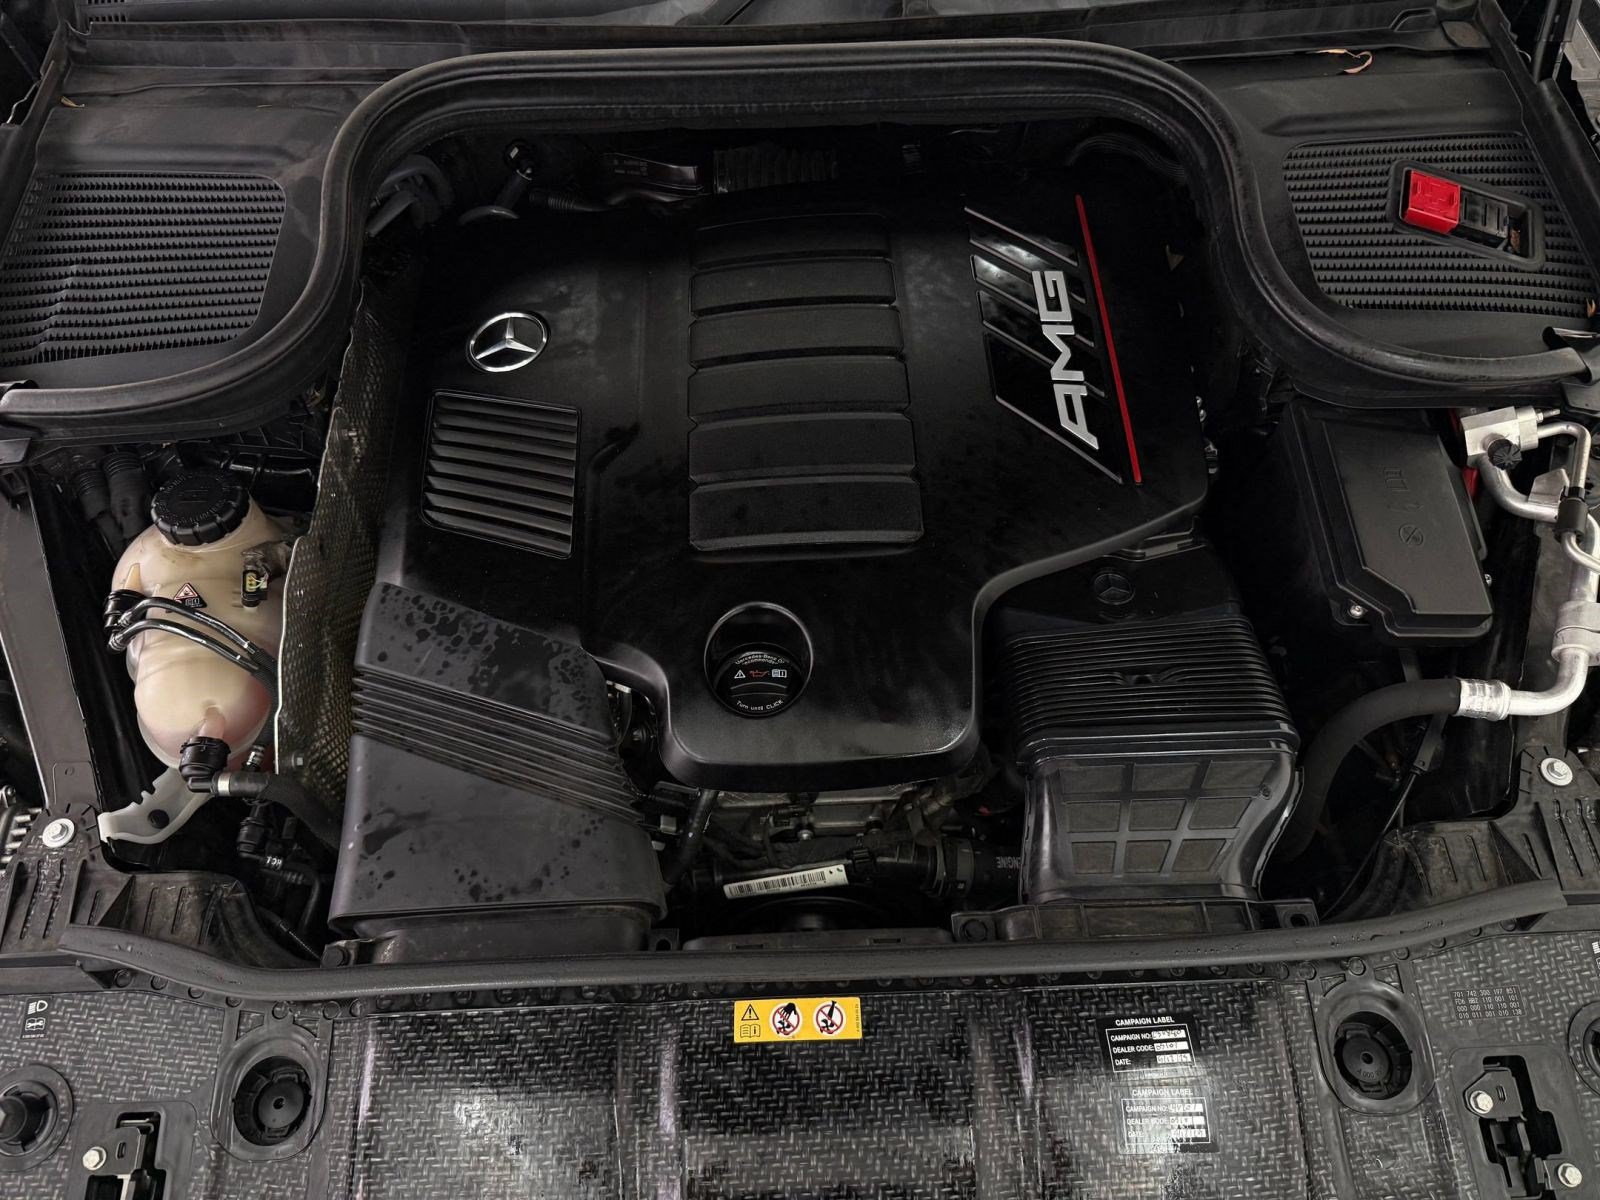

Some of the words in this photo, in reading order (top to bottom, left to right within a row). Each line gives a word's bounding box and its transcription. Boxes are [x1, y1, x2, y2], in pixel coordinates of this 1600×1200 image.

[1032, 271, 1099, 450] AMG
[736, 700, 748, 709] Turn
[1115, 1018, 1152, 1026] CAMPAIGN
[1110, 1033, 1140, 1042] CAMPAIGN
[1113, 1045, 1136, 1053] DEALER
